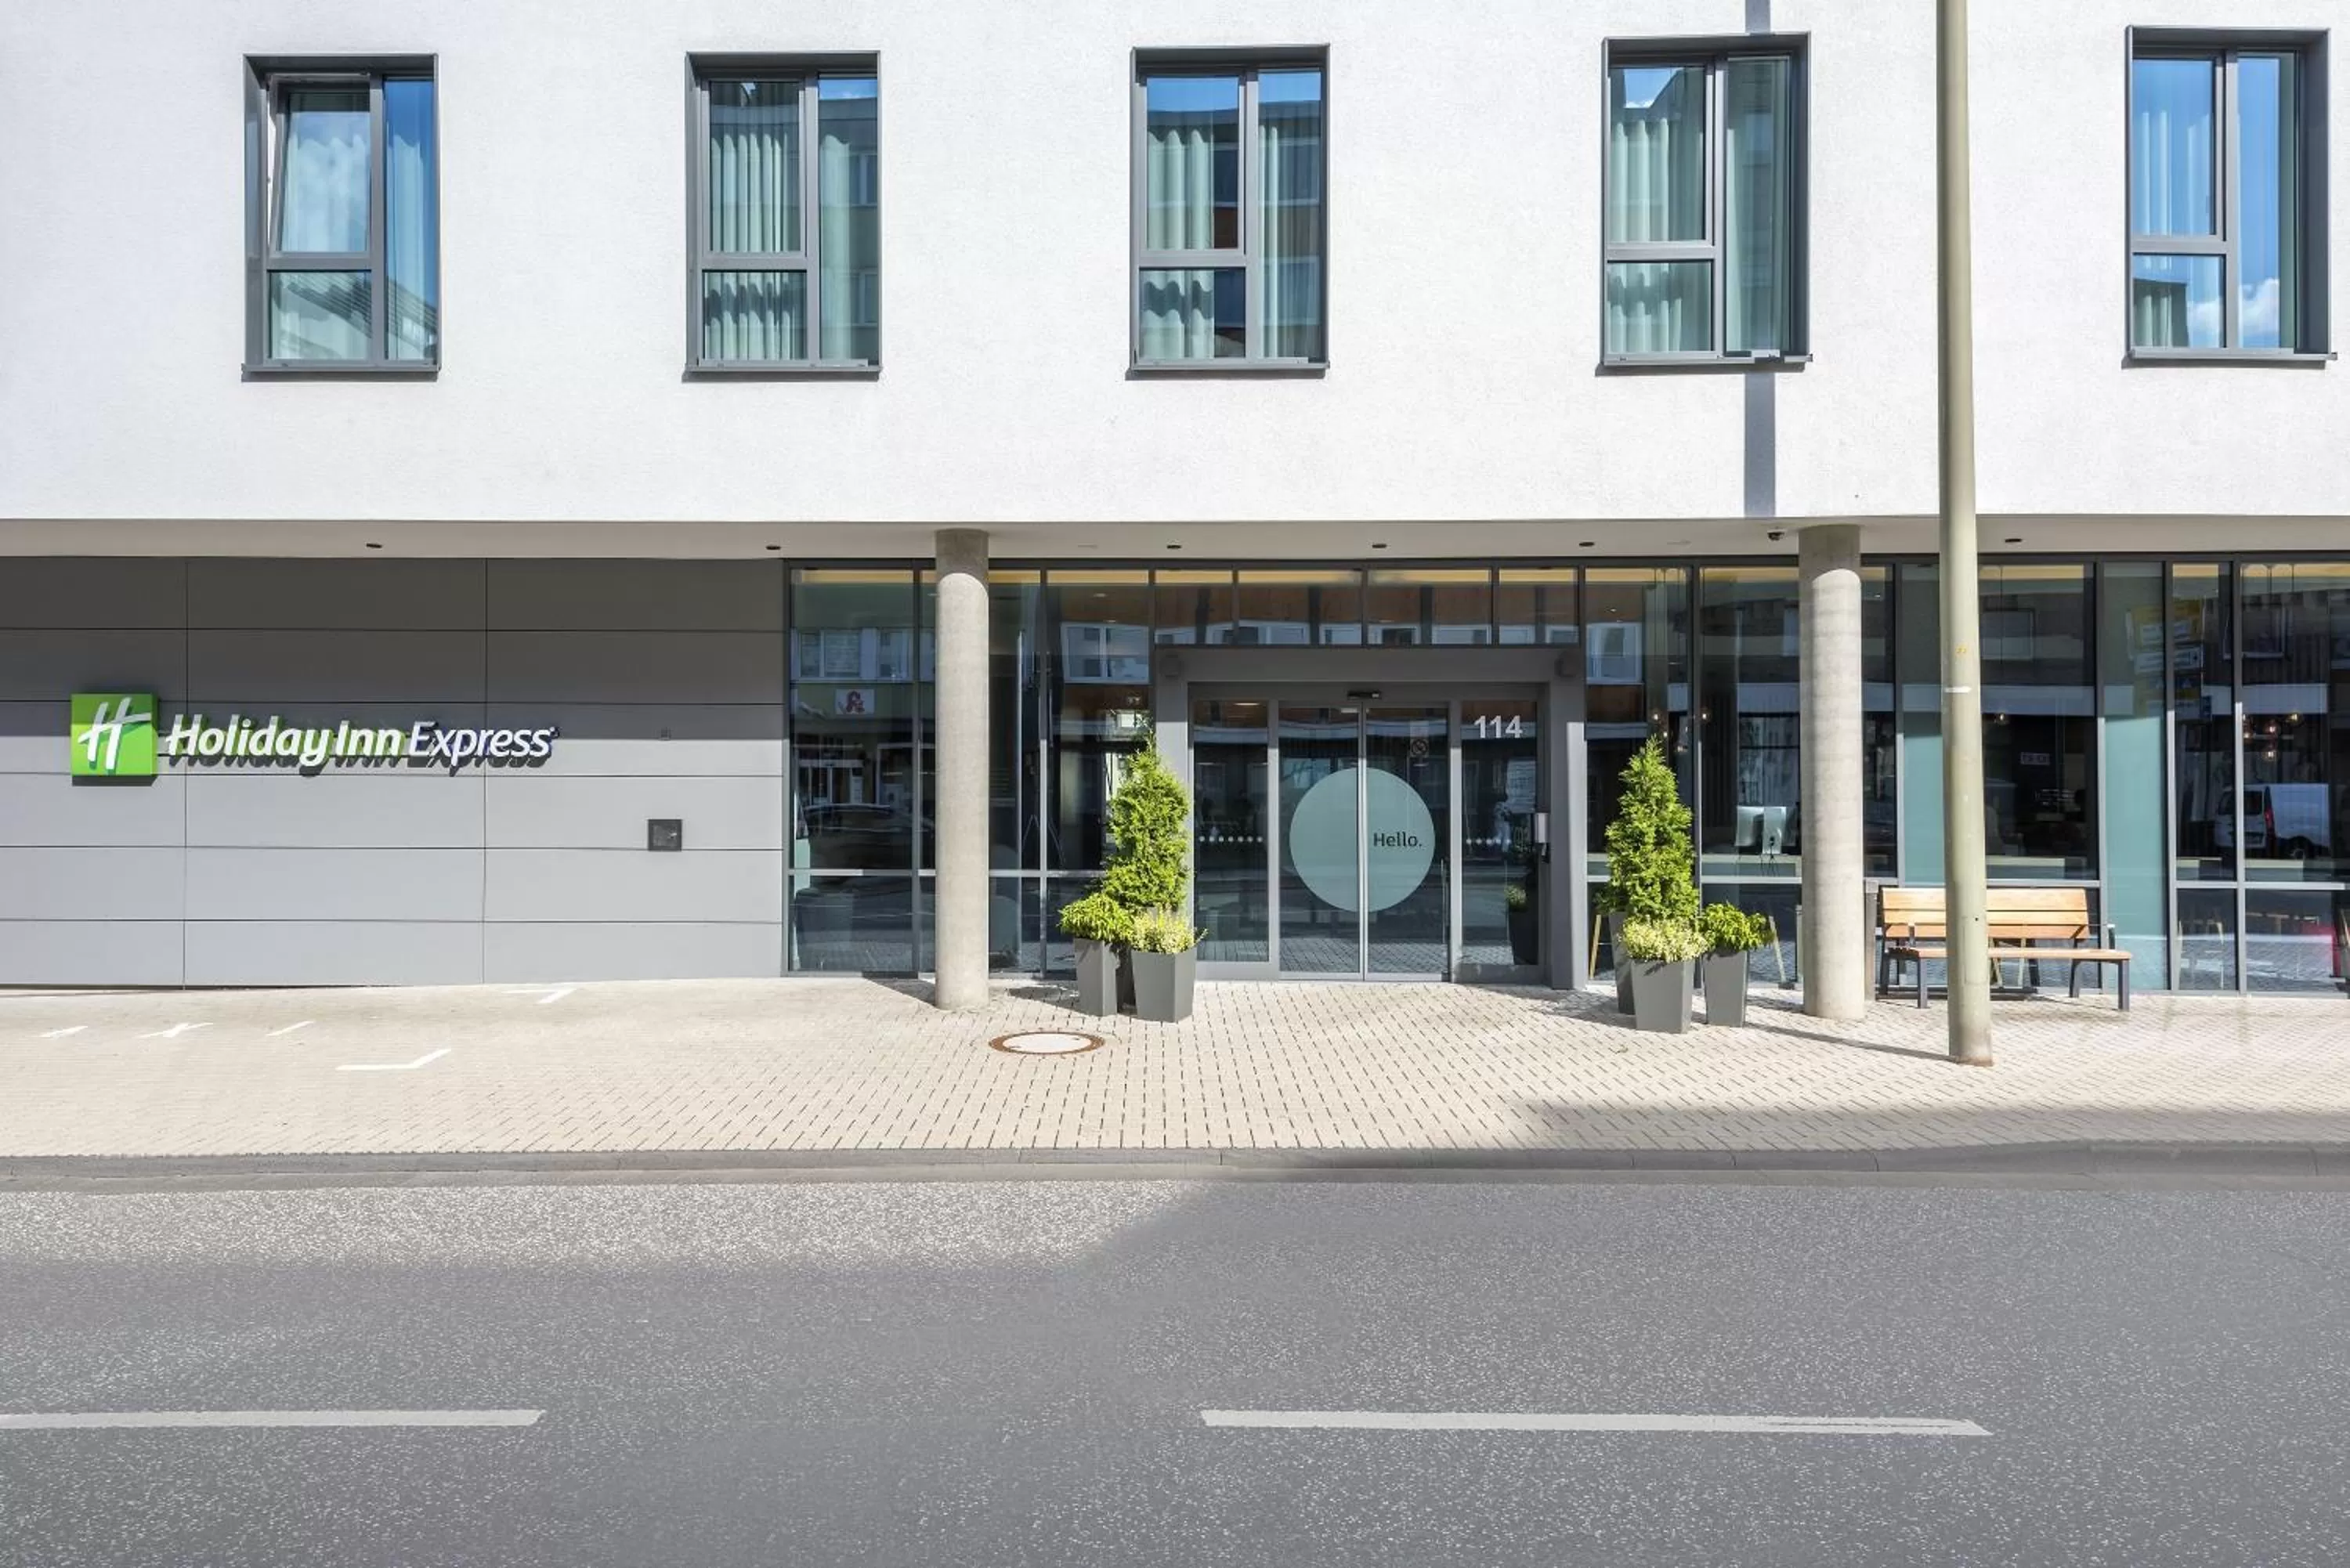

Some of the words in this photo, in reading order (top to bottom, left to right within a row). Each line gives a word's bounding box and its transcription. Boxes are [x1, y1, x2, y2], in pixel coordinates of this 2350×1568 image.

[1474, 715, 1524, 739] 114
[166, 714, 330, 766] Holiday
[335, 721, 401, 756] Inn
[408, 721, 553, 767] Express
[1373, 831, 1423, 847] Hello.
